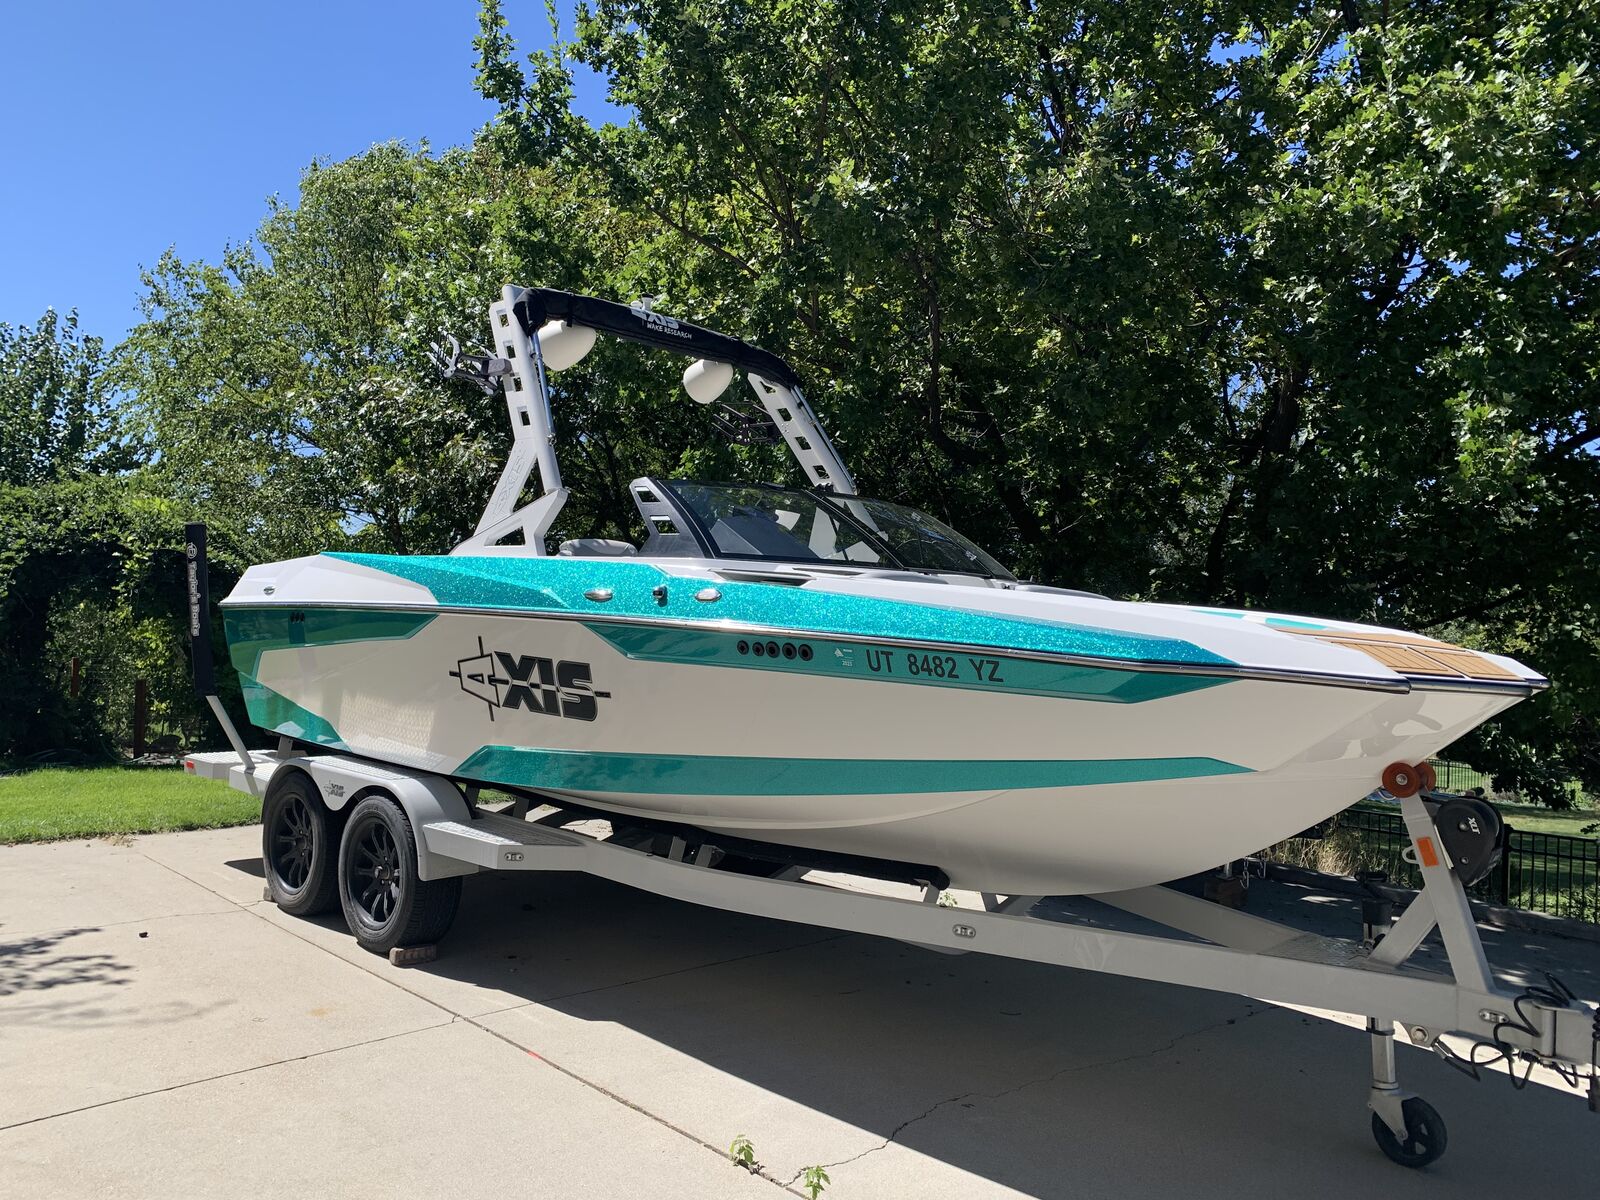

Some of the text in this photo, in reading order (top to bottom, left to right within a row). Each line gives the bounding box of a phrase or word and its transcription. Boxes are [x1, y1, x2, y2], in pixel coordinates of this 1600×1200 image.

[647, 323, 692, 339] WAKE RESEARCH
[190, 604, 201, 637] Boats
[866, 649, 1004, 682] UT 8482 YZ
[454, 646, 603, 722] AXIS
[1467, 817, 1481, 835] XLT
